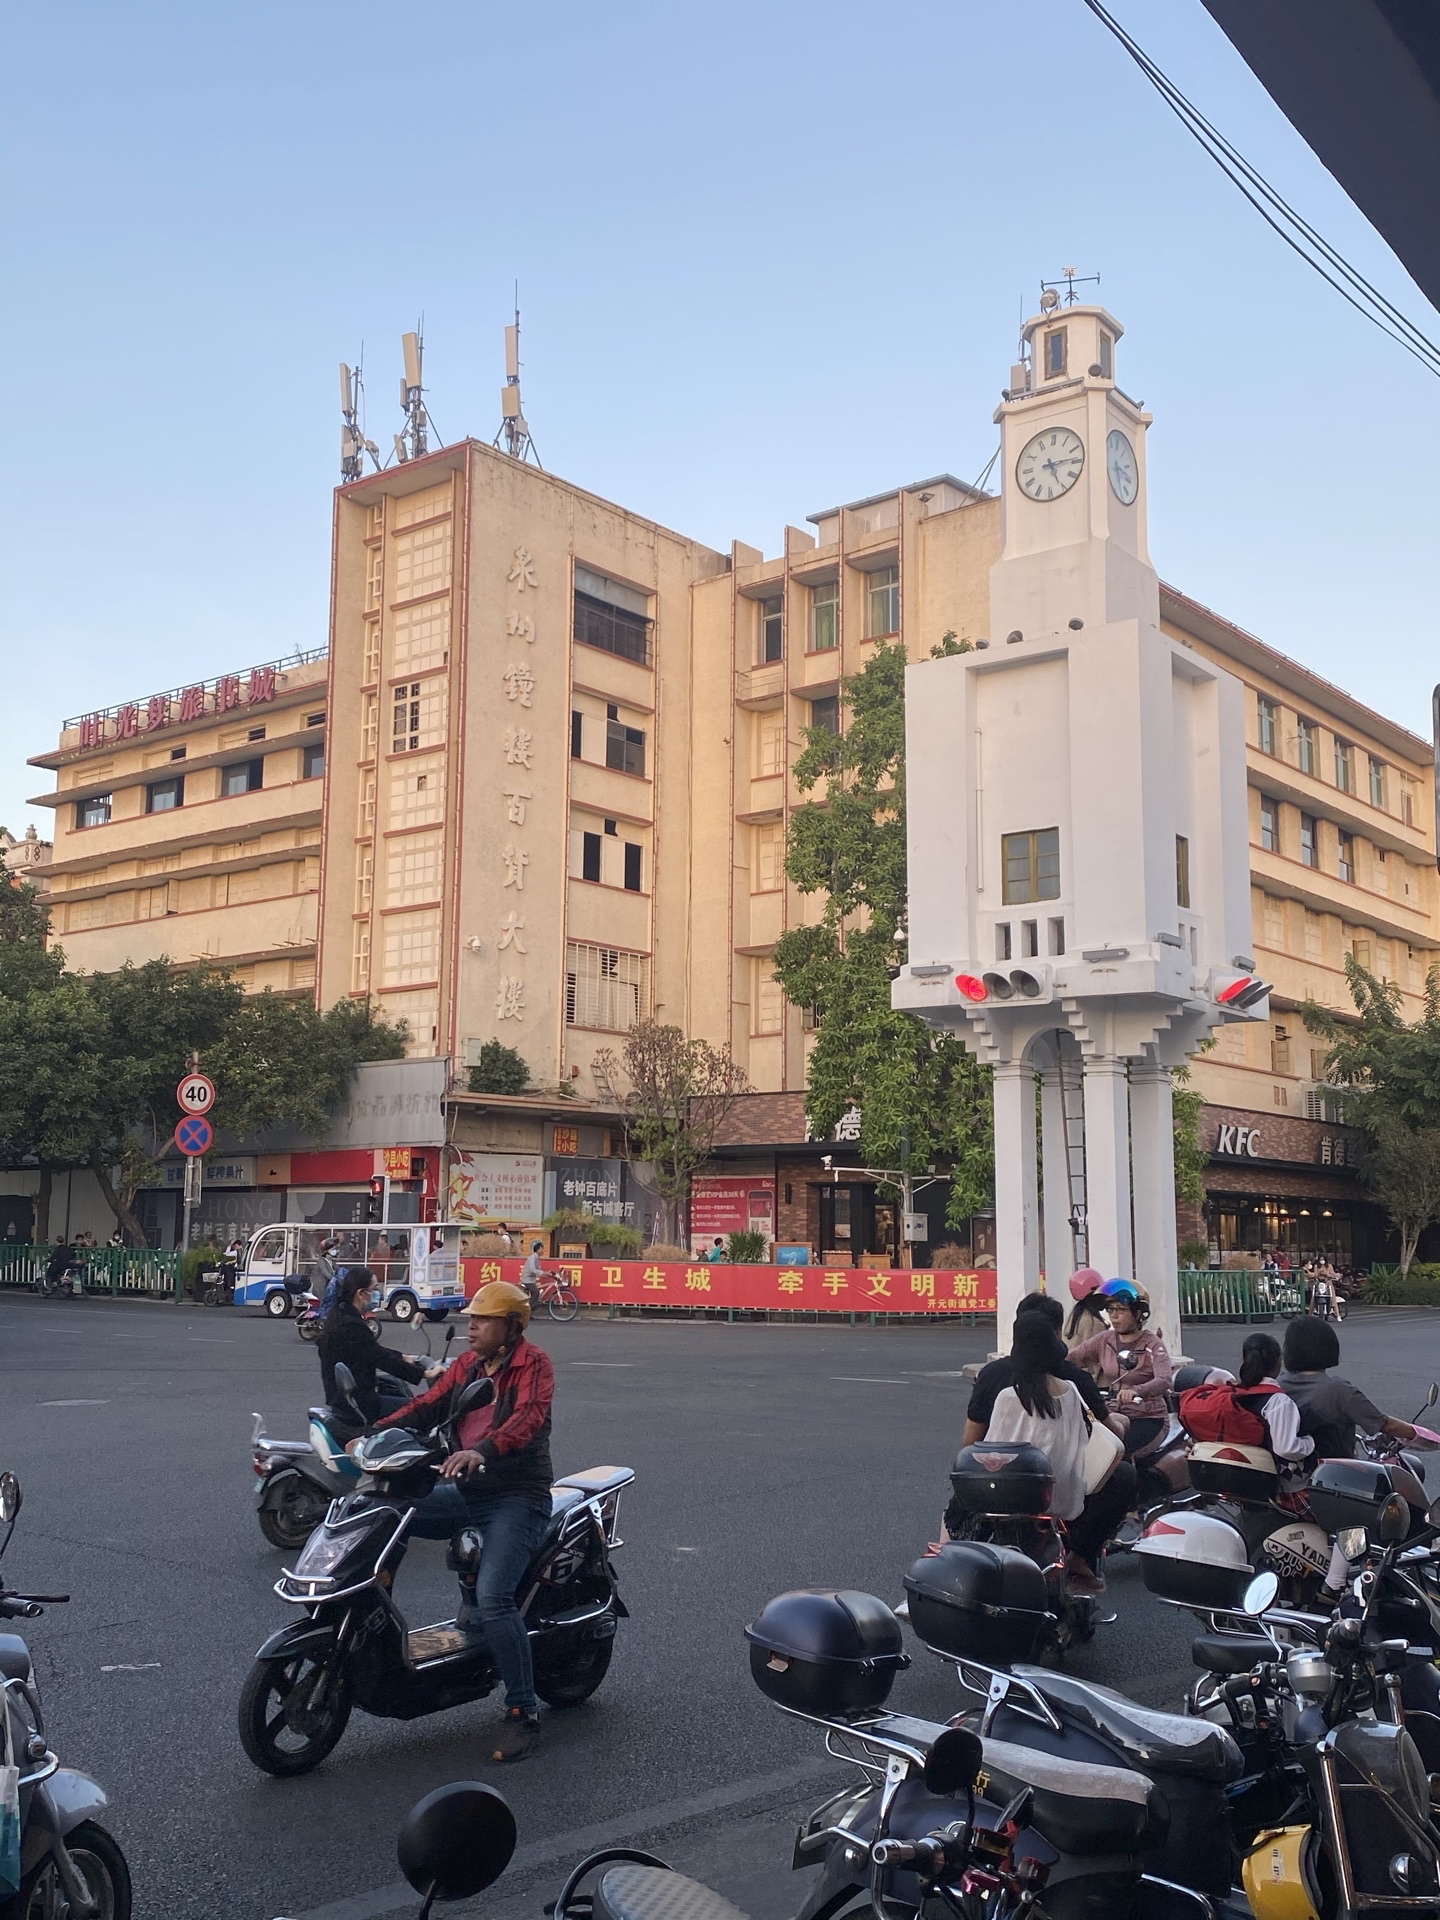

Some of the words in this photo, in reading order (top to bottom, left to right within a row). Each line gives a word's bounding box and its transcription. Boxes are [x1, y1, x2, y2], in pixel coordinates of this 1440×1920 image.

[186, 1086, 207, 1103] 40
[1217, 1124, 1261, 1157] KFC
[563, 1180, 617, 1197] 老钟百底片
[582, 1200, 635, 1217] 新古城客厅
[927, 1298, 997, 1309] 开元街道党工委
